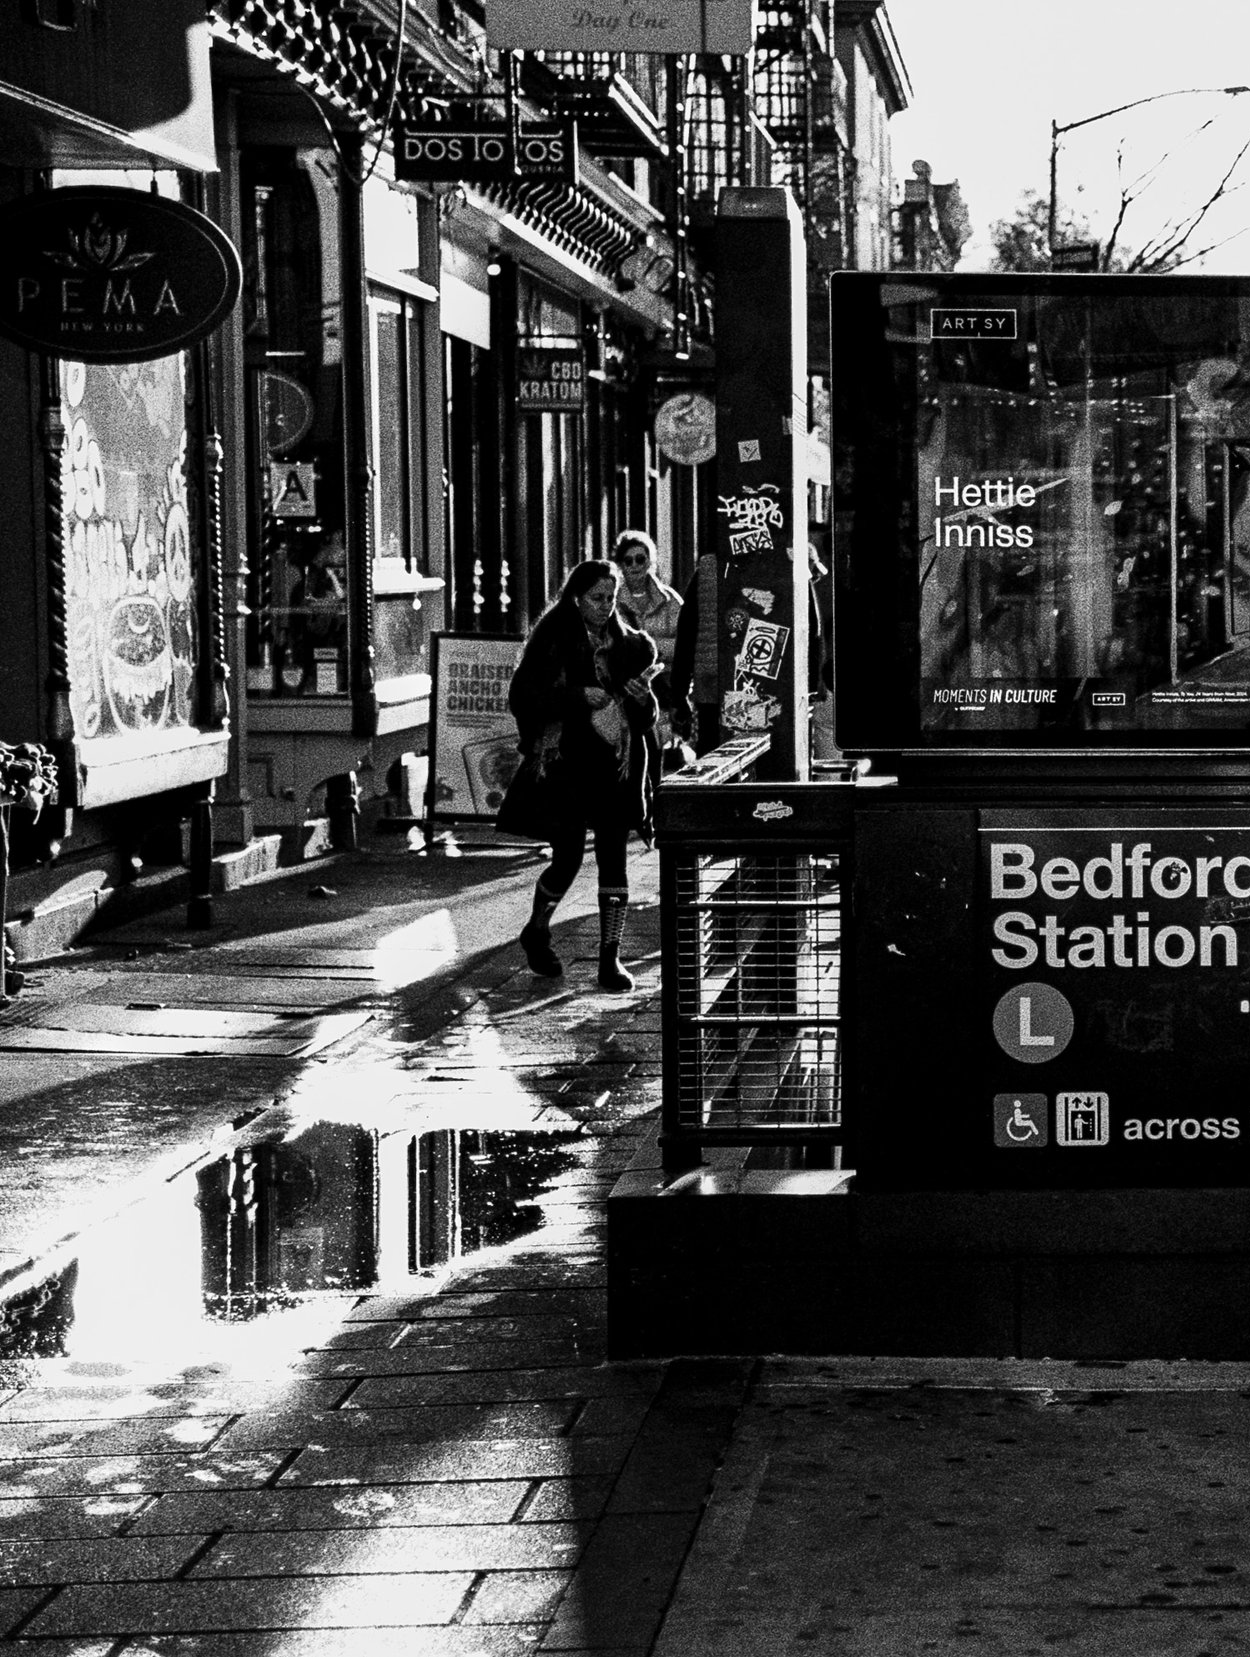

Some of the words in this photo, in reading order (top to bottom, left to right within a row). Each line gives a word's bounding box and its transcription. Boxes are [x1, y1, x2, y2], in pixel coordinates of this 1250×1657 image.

[405, 138, 463, 161] DOS
[473, 137, 564, 163] TOOS
[18, 277, 182, 316] PEMA
[60, 321, 93, 332] NEW
[103, 321, 144, 332] YORK
[552, 361, 581, 379] CBD
[520, 381, 582, 399] KRATOM
[281, 471, 307, 501] A
[934, 476, 1036, 507] Hettie
[935, 517, 1034, 547] Inniss
[448, 662, 514, 680] BRAISED
[448, 680, 501, 696] ANCHO
[933, 689, 987, 704] MOMENTS
[990, 689, 1002, 704] IN
[1005, 689, 1057, 704] CULTURE
[991, 911, 1238, 968] Station
[1019, 996, 1055, 1046] L
[1123, 1115, 1241, 1141] across
